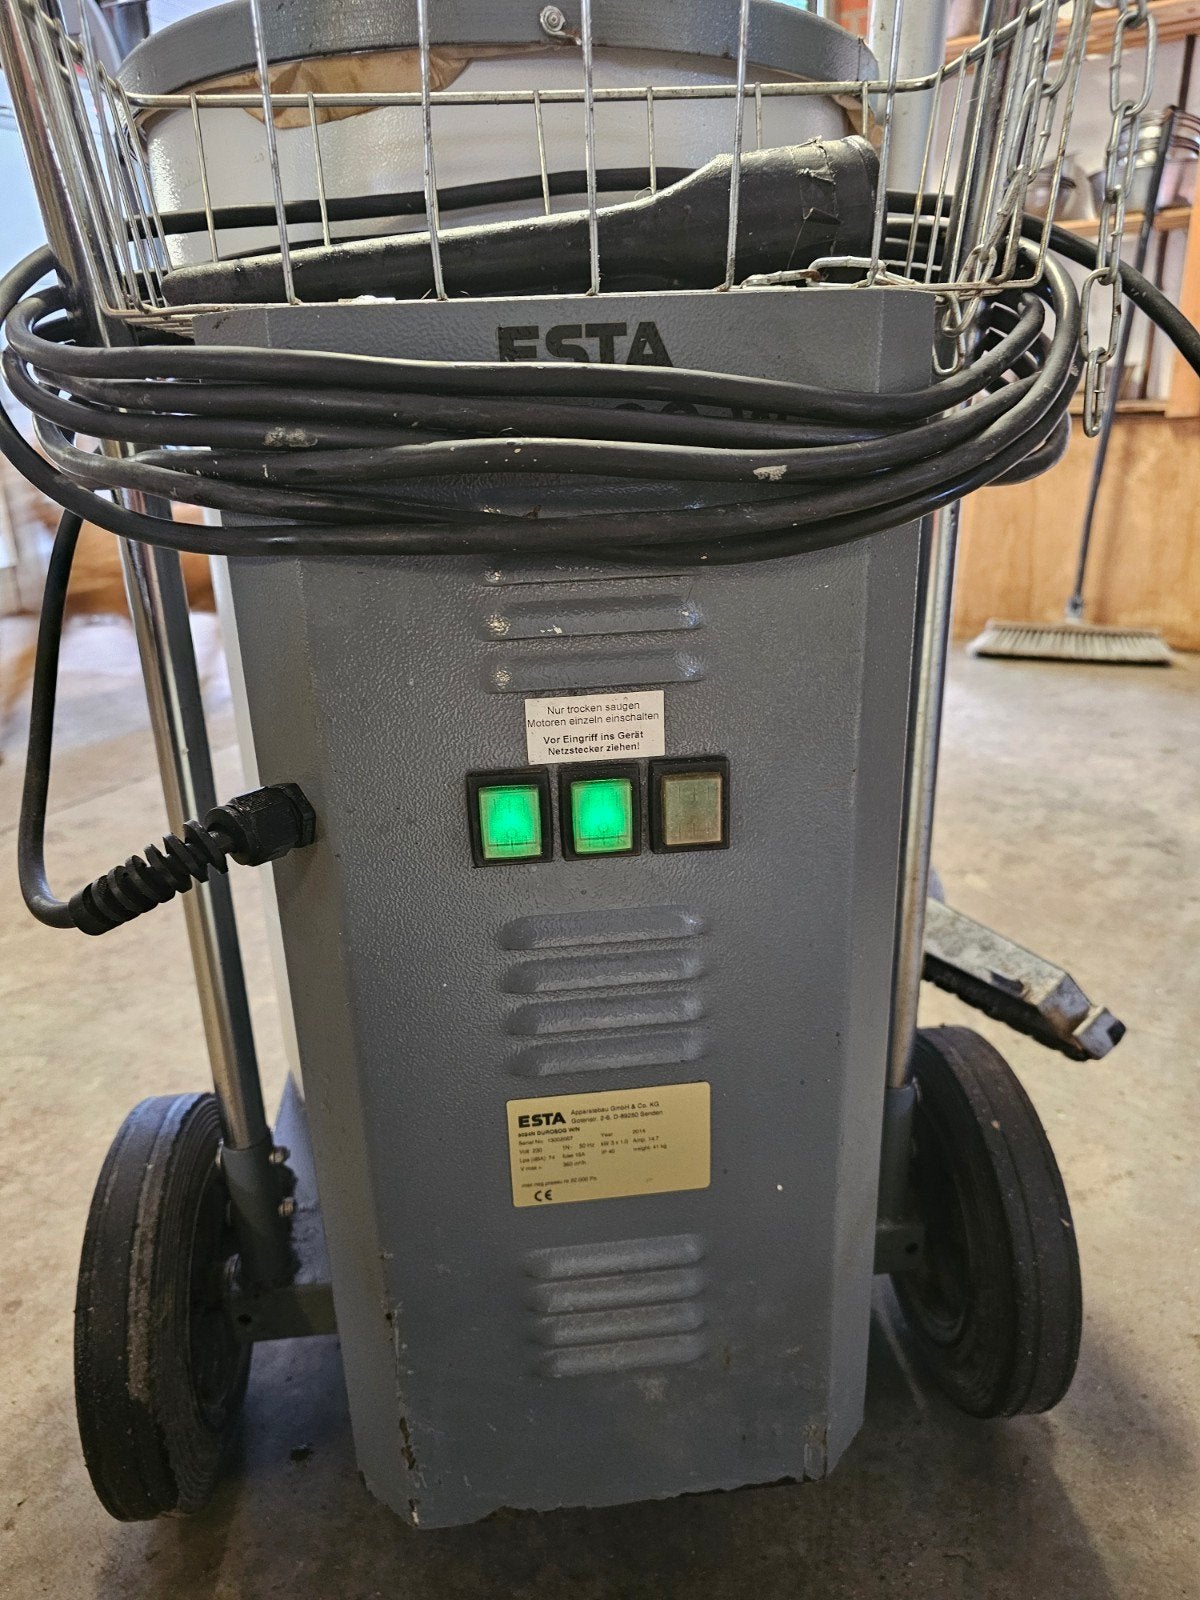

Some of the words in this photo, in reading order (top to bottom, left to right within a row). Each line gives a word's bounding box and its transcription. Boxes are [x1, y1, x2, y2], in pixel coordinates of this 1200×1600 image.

[498, 321, 674, 367] ESTA
[547, 706, 564, 715] Nur
[567, 704, 602, 714] trocken
[605, 702, 640, 711] saugen
[527, 719, 566, 728] Motoren
[569, 716, 603, 726] einzeln
[606, 711, 659, 723] einschalten
[543, 736, 560, 744] Vor
[563, 733, 598, 744] Eingriff
[600, 732, 615, 741] ins
[617, 730, 644, 740] Gerät
[548, 745, 603, 756] Netzstecker
[606, 743, 640, 752] ziehen!
[570, 1106, 609, 1116] Apparatebau
[610, 1104, 630, 1112] GmbH
[640, 1109, 663, 1118] Senden
[518, 1111, 566, 1129] ESTA
